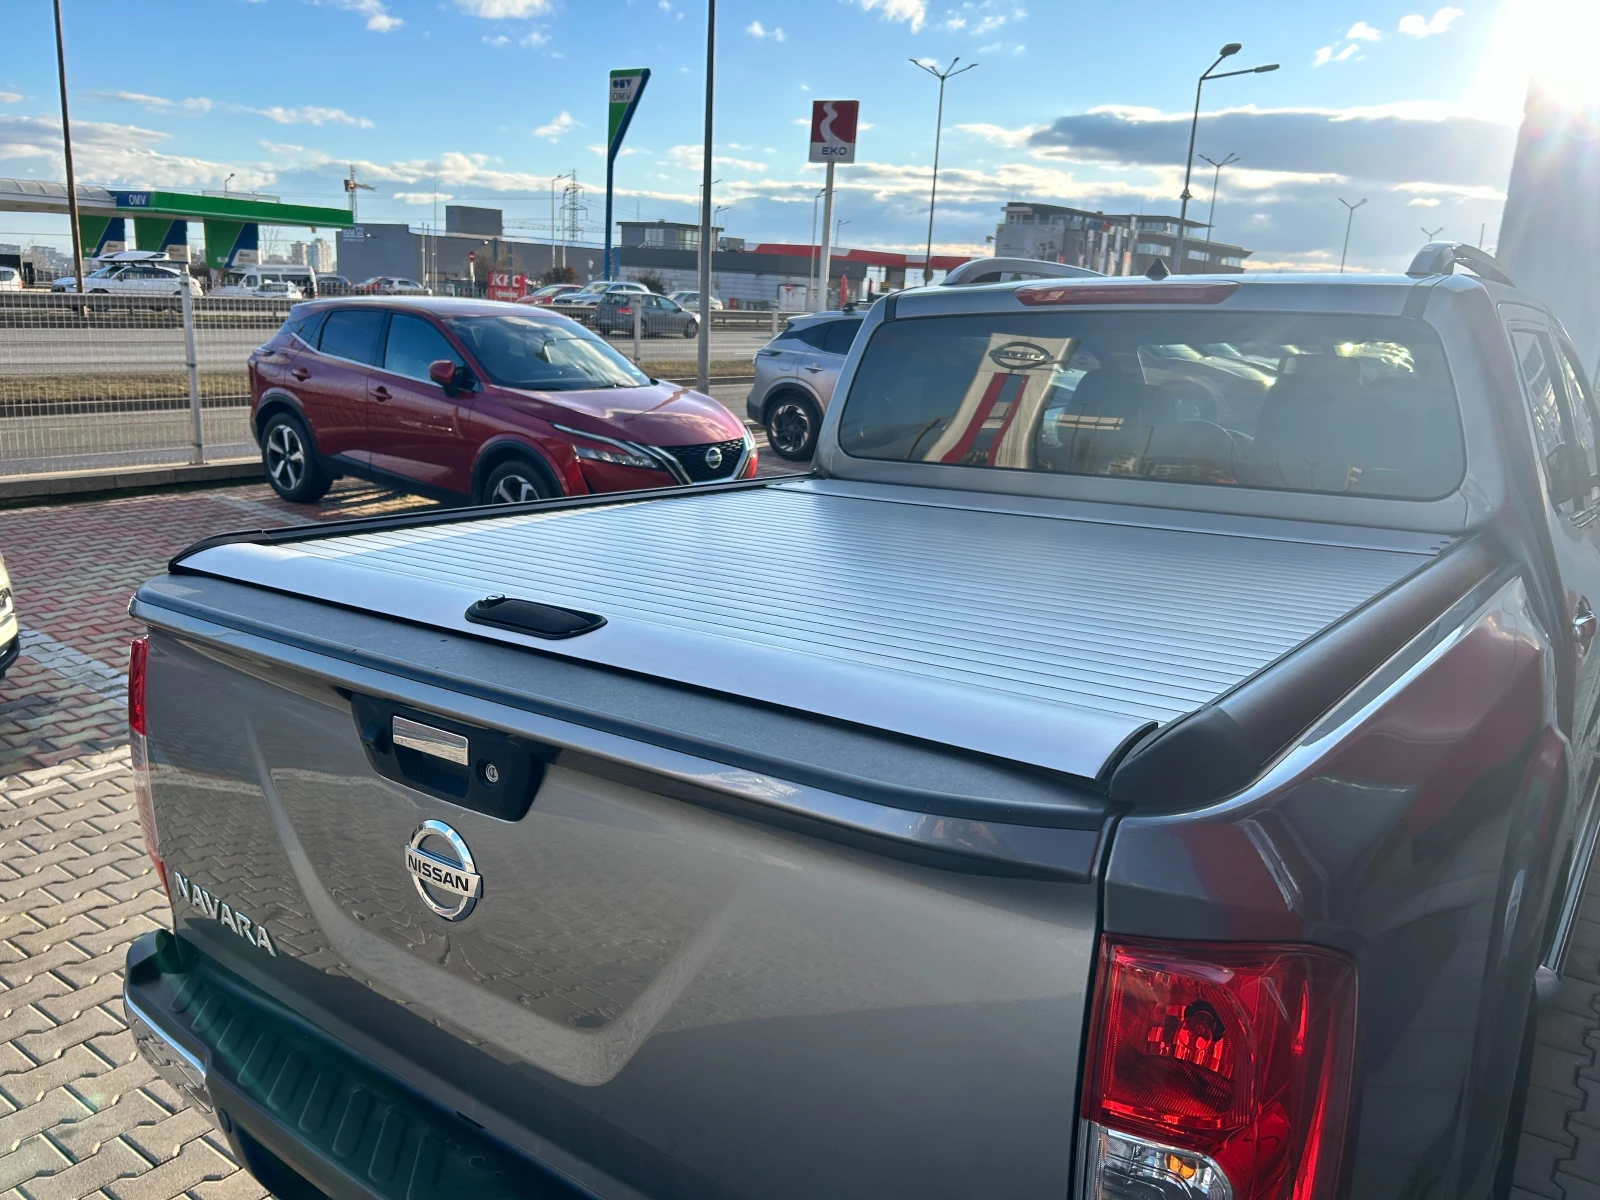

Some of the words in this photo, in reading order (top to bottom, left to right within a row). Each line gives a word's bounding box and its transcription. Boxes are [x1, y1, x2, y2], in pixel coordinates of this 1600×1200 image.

[612, 92, 632, 101] OMV
[821, 146, 847, 156] EKO
[128, 194, 147, 206] OMV
[408, 854, 469, 892] NISSAN
[174, 871, 277, 958] NAVARA
